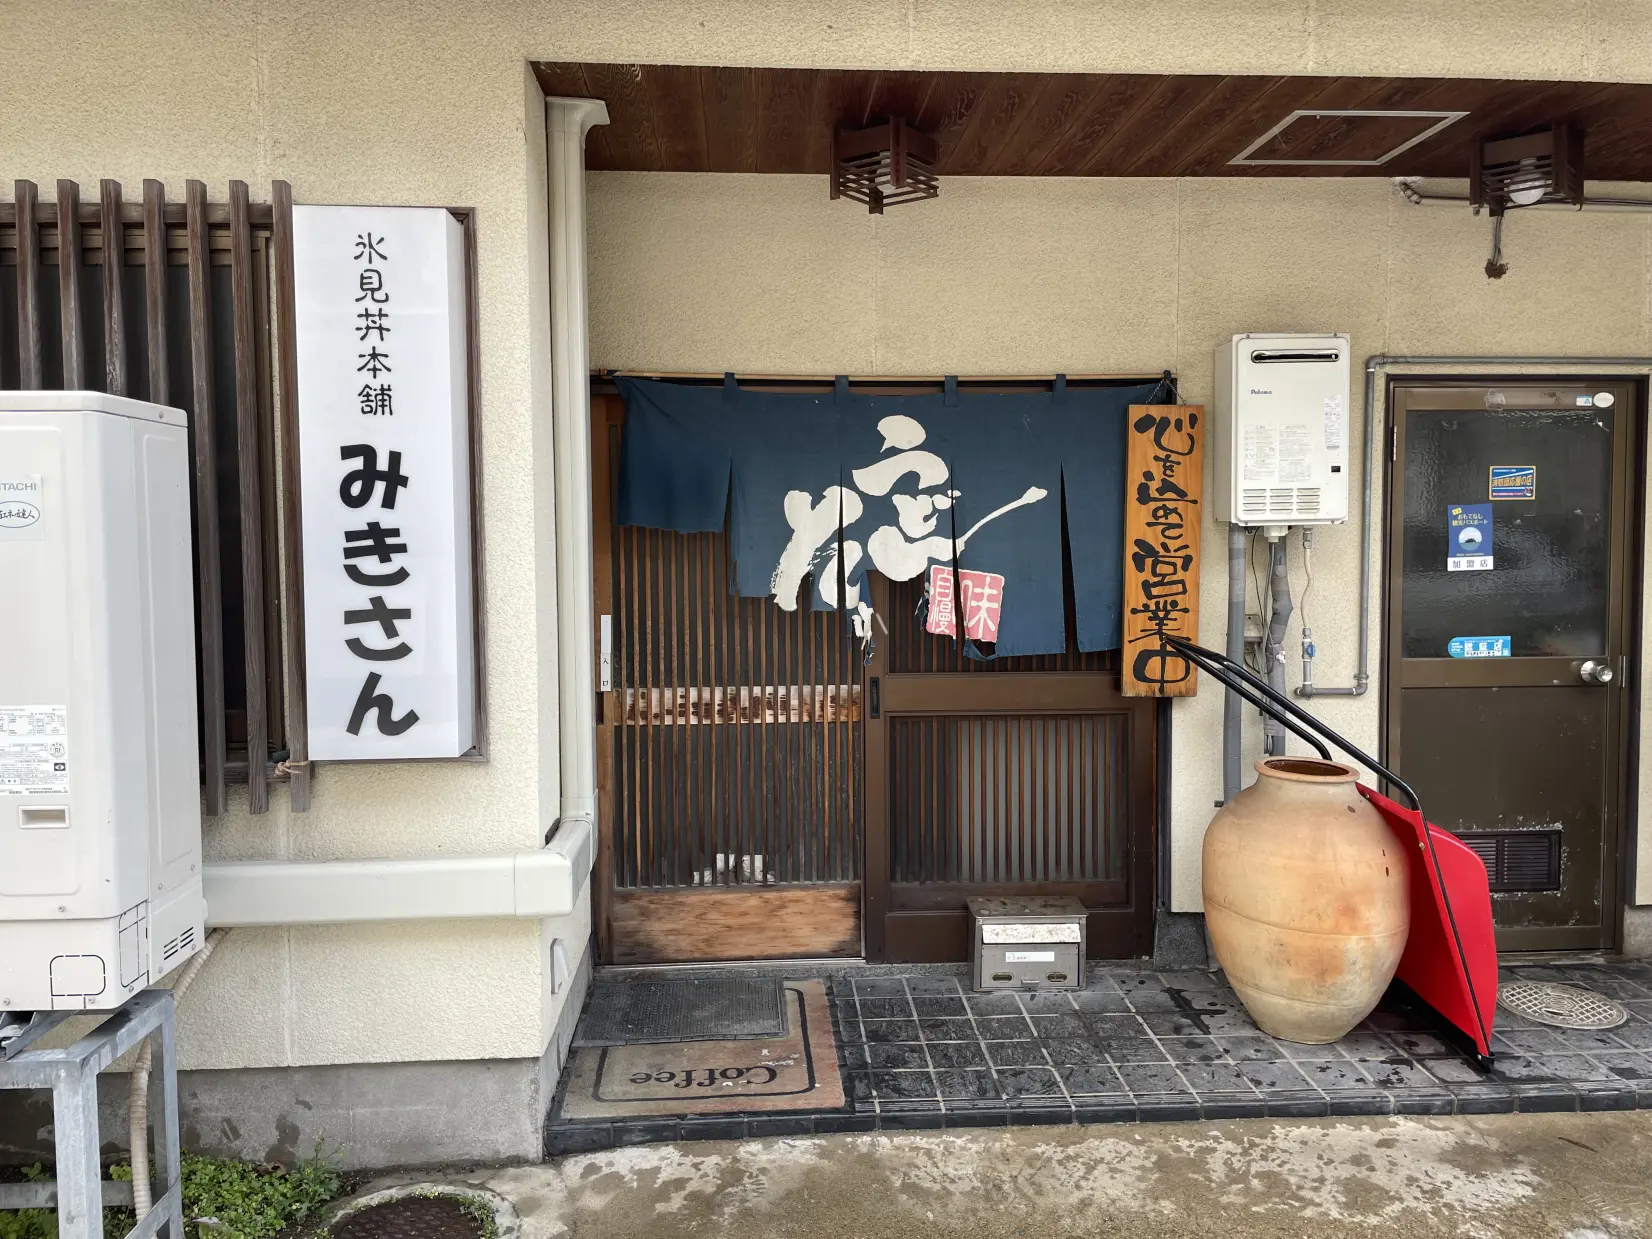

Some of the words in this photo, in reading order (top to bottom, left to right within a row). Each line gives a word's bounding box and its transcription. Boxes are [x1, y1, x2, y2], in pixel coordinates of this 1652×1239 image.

[353, 231, 394, 416] 氷見丼本舗
[0, 482, 37, 491] TACHI
[338, 442, 421, 738] みきさん
[1127, 412, 1199, 695] 心を込めて営業中
[602, 656, 609, 687] 入口
[629, 1065, 779, 1089] Coffee
